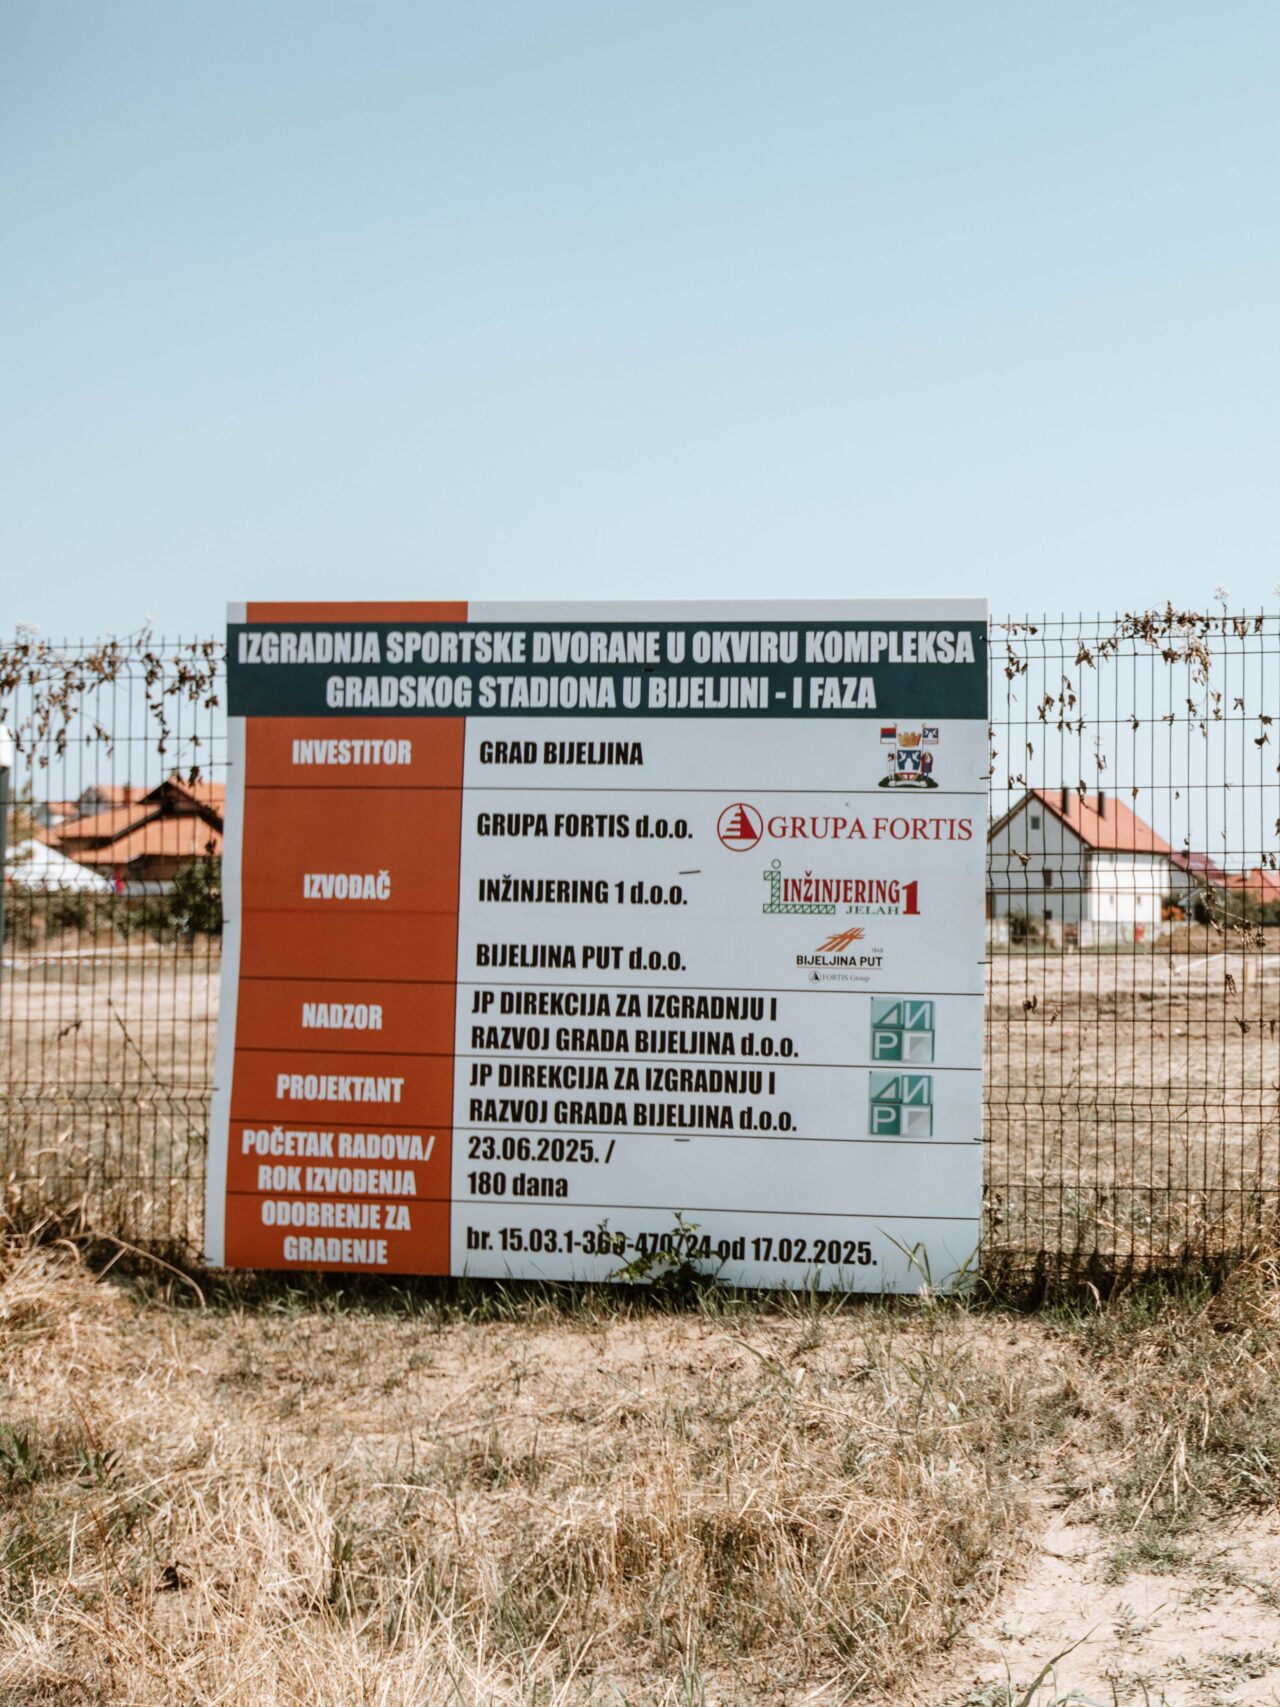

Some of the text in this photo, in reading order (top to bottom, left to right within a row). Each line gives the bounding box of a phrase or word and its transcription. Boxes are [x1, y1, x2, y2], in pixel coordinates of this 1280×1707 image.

[238, 631, 975, 664] IZGRADNJA SPORTSKE DVORANE U OKVIRU KOMPLEKSA
[326, 675, 877, 709] GRADSKOG STADIONA U BIJELJINI - I FAZA
[292, 739, 411, 765] INVESTITOR
[479, 740, 643, 766] GRAD BIJELJINA
[477, 813, 693, 839] GRUPA FORTIS d.o.o.
[767, 816, 972, 841] GRUPA FORTIS
[303, 870, 391, 901] IZVOĐAČ
[478, 874, 688, 905] INŽINJERING 1 d.o.o.
[783, 870, 920, 915] INŽINJERING 1
[846, 905, 899, 916] JELAH
[476, 943, 686, 971] BIJELJINA PUT d.o.o.
[796, 955, 883, 967] BIJELJINA PUT
[302, 1002, 382, 1030] NADZOR
[472, 991, 777, 1021] JP DIREKCIJA ZA IZGRADNJU I
[471, 1026, 799, 1058] RAZVOJ GRADA BIJELJINA d.o.o.
[276, 1074, 404, 1103] PROJEKTANT
[470, 1063, 775, 1095] JP DIREKCIJA ZA IZGRADNJU I
[469, 1099, 797, 1132] RAZVOJ GRADA BIJELJINA d.o.o.
[242, 1126, 435, 1162] POČETAK RADOVA/
[468, 1136, 616, 1164] 23.06.2025. /
[258, 1165, 416, 1195] ROK IZVOĐENJA
[467, 1172, 568, 1198] 180 dana
[261, 1201, 411, 1231] ODOBRENJE ZA
[284, 1236, 388, 1265] GRAĐENJE
[467, 1226, 493, 1251] br.
[718, 1236, 745, 1261] od
[751, 1237, 878, 1266] 17.02.2025.
